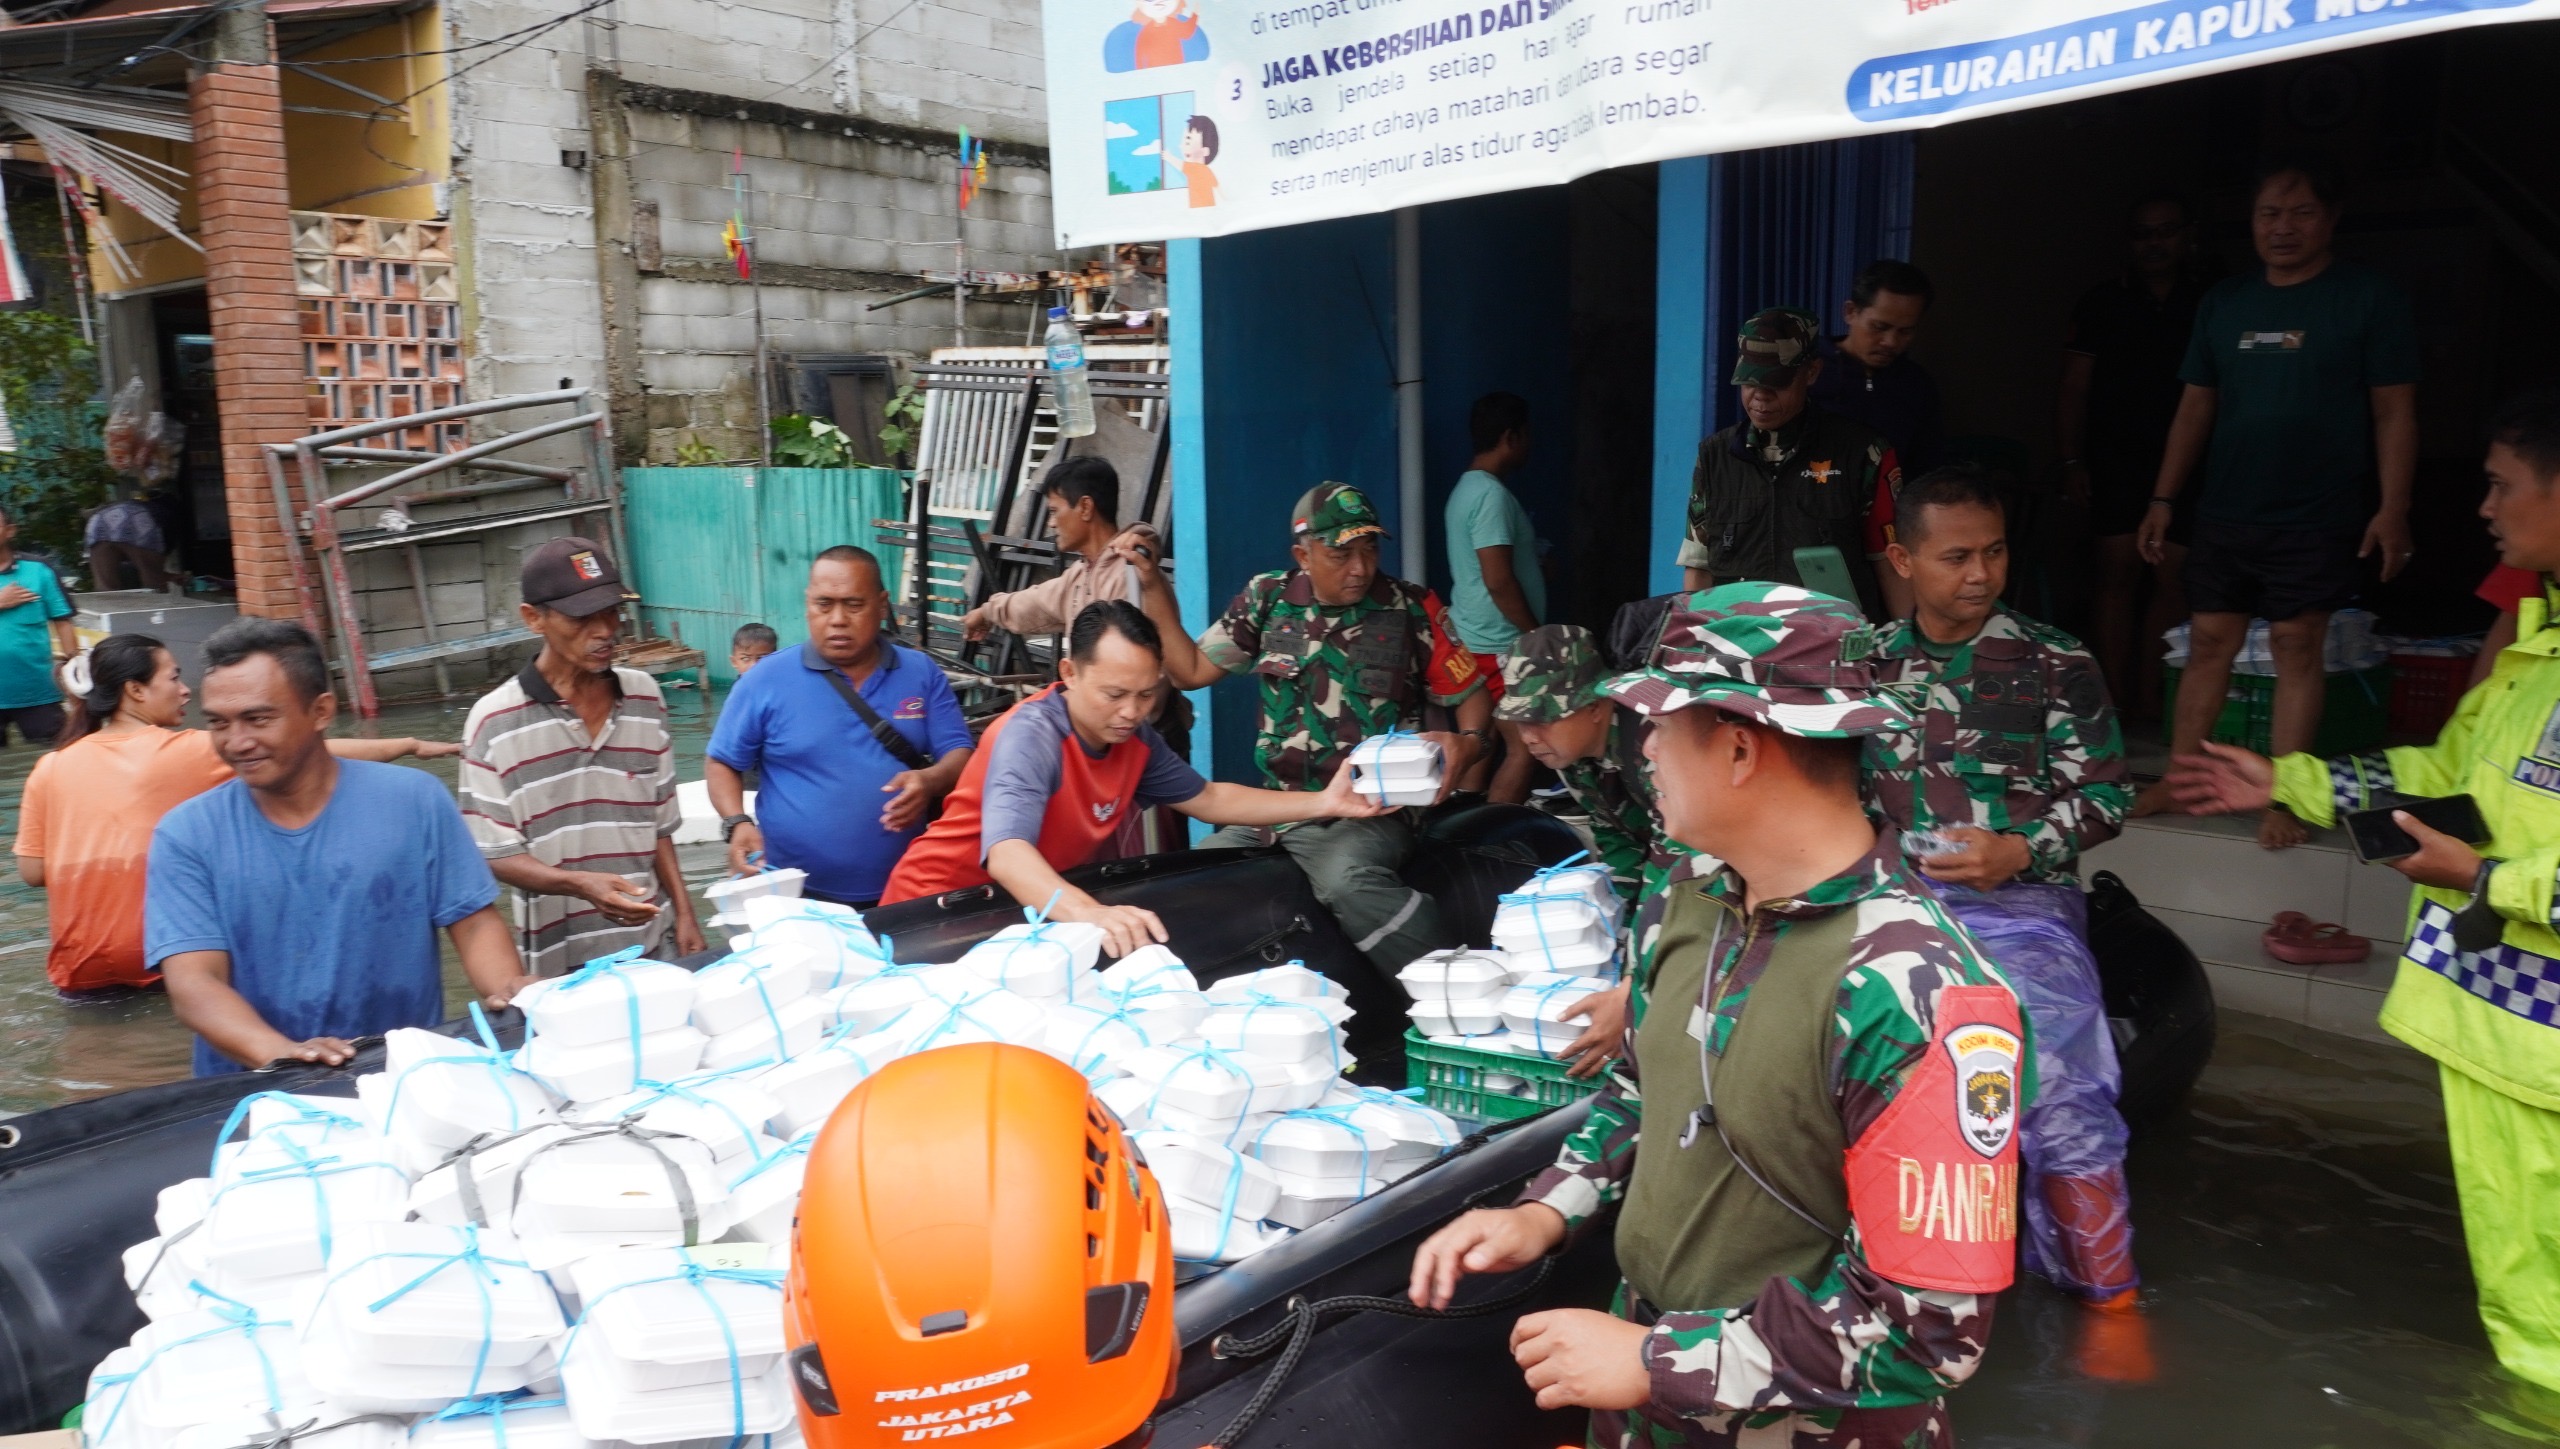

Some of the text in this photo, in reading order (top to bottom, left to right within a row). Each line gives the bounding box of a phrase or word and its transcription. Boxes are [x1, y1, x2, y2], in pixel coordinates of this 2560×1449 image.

[1250, 0, 1350, 35] di tempat
[1262, 54, 1319, 88] JAGA
[1480, 0, 1532, 35] DAN
[1868, 0, 2294, 108] KELURAHAN KAPUK
[1231, 78, 1242, 101] 3
[1266, 94, 1313, 119] Buka
[1338, 71, 1405, 112] jendela
[1428, 52, 1497, 82] setiap
[1271, 124, 1365, 158] mendapat
[1372, 107, 1439, 136] cahaya
[1448, 78, 1549, 120] matahari
[1635, 41, 1713, 75] segar
[1270, 173, 1315, 196] serta
[1322, 153, 1416, 186] menjemur
[1422, 143, 1464, 167] alas
[1471, 131, 1526, 160] tidur
[1599, 89, 1707, 126] lembab.
[874, 1363, 1030, 1403] PRAKOSO
[877, 1390, 1032, 1427] JAKARTA
[902, 1411, 1015, 1441] UTARA
